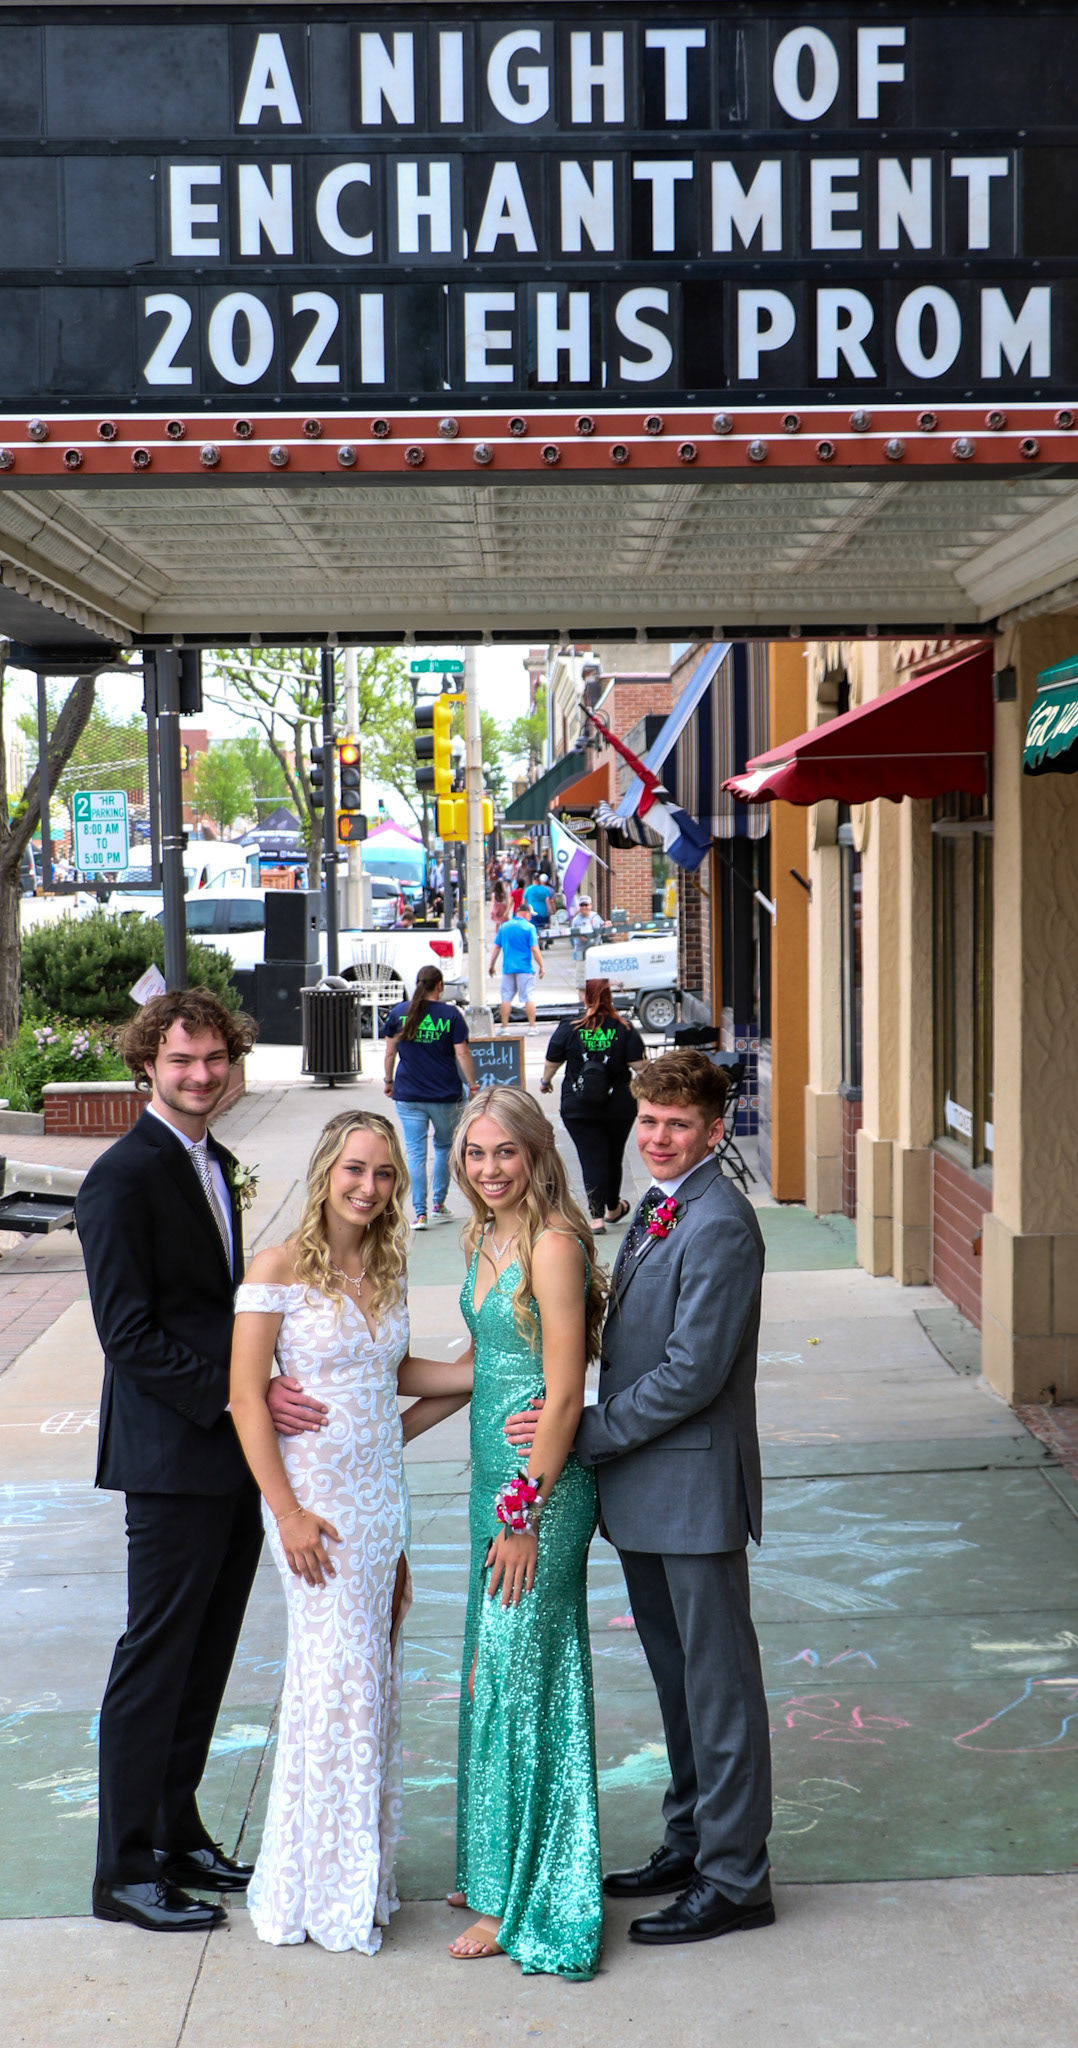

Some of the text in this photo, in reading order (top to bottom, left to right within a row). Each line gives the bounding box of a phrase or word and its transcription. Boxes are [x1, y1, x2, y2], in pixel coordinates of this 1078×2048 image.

[239, 26, 906, 125] A NIGHT OF
[169, 157, 1008, 257] ENCHANTMENT
[143, 286, 1051, 385] 2021 EHS PROM
[77, 795, 115, 817] 2 HR
[92, 807, 125, 818] PARKING
[83, 823, 119, 835] 8:00 AM
[96, 837, 108, 849] TO
[84, 852, 120, 864] 5:00 PM
[599, 957, 638, 966] WACKER
[600, 963, 639, 973] NEUSON
[469, 1042, 495, 1057] ood
[479, 1045, 514, 1069] Luck!
